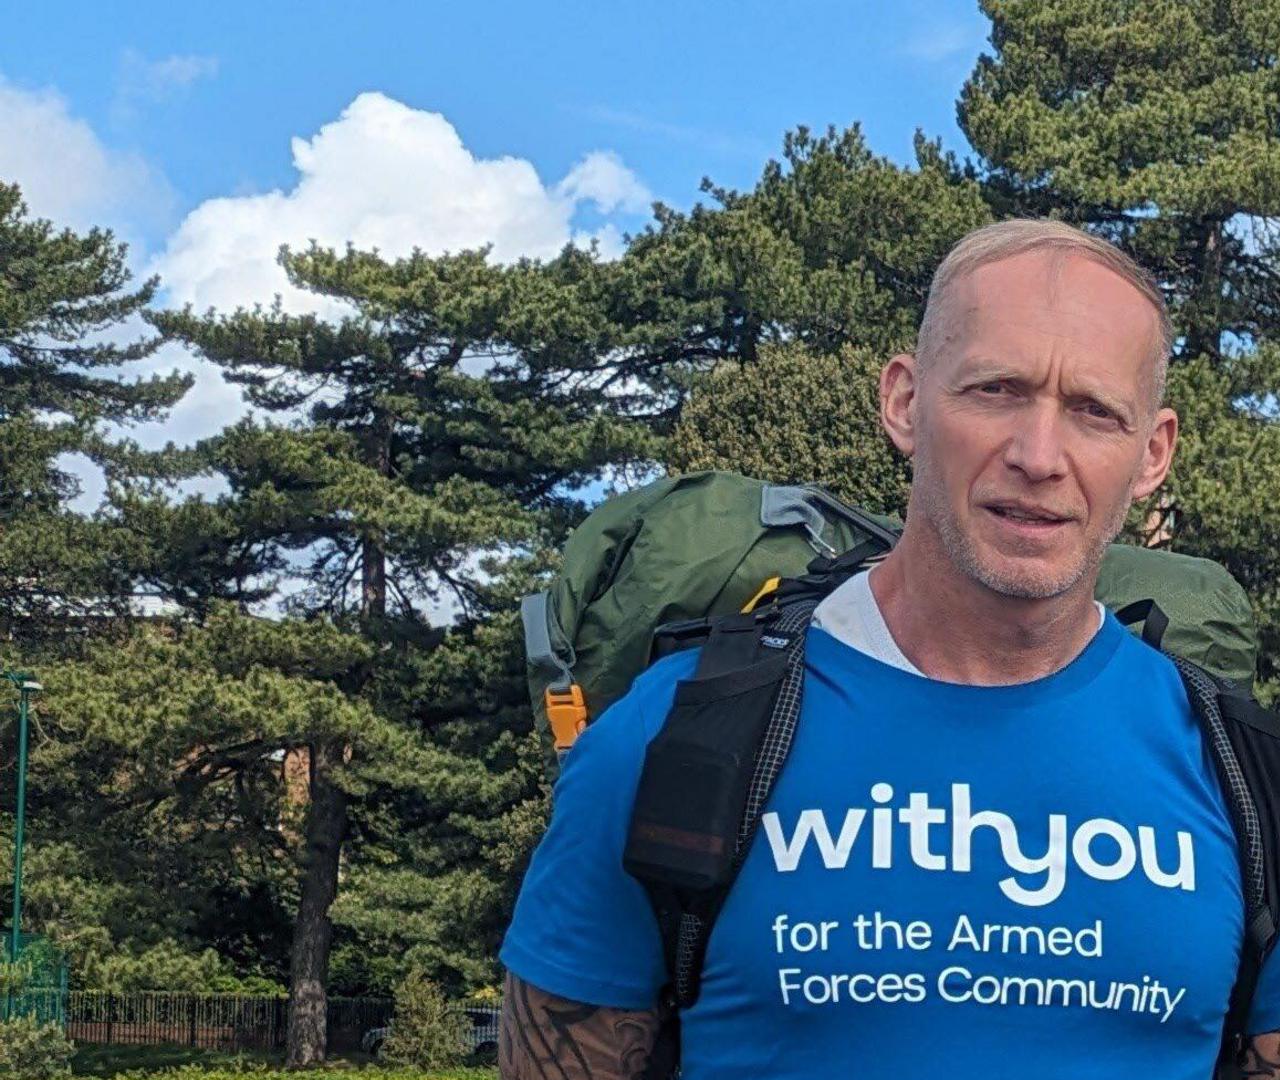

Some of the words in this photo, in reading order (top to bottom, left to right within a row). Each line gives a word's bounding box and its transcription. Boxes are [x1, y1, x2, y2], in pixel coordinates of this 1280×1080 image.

[761, 782, 1196, 907] withyou
[772, 914, 838, 953] for
[853, 911, 931, 951] the
[948, 914, 1103, 957] Armed
[778, 967, 926, 1005] Forces
[937, 966, 1186, 1023] Community
